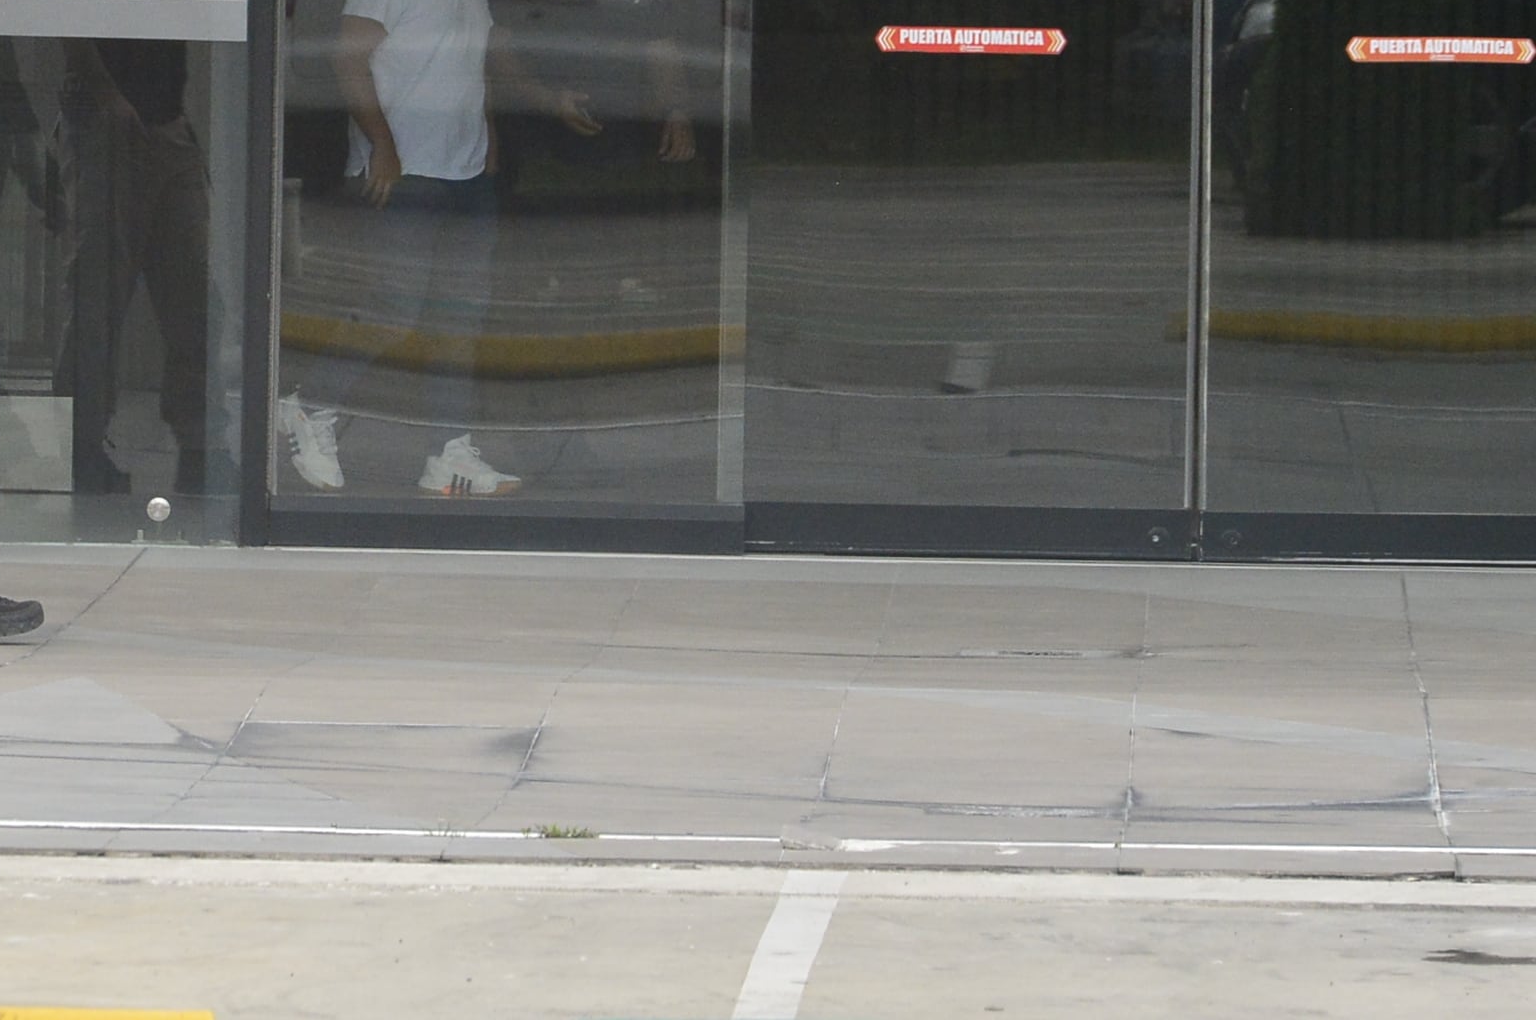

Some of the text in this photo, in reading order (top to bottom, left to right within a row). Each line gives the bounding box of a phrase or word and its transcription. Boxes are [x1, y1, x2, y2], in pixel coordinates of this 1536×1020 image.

[900, 28, 1044, 46] PUERTA AUTOMATICA
[1370, 39, 1514, 55] PUERTA AUTOMATICA
